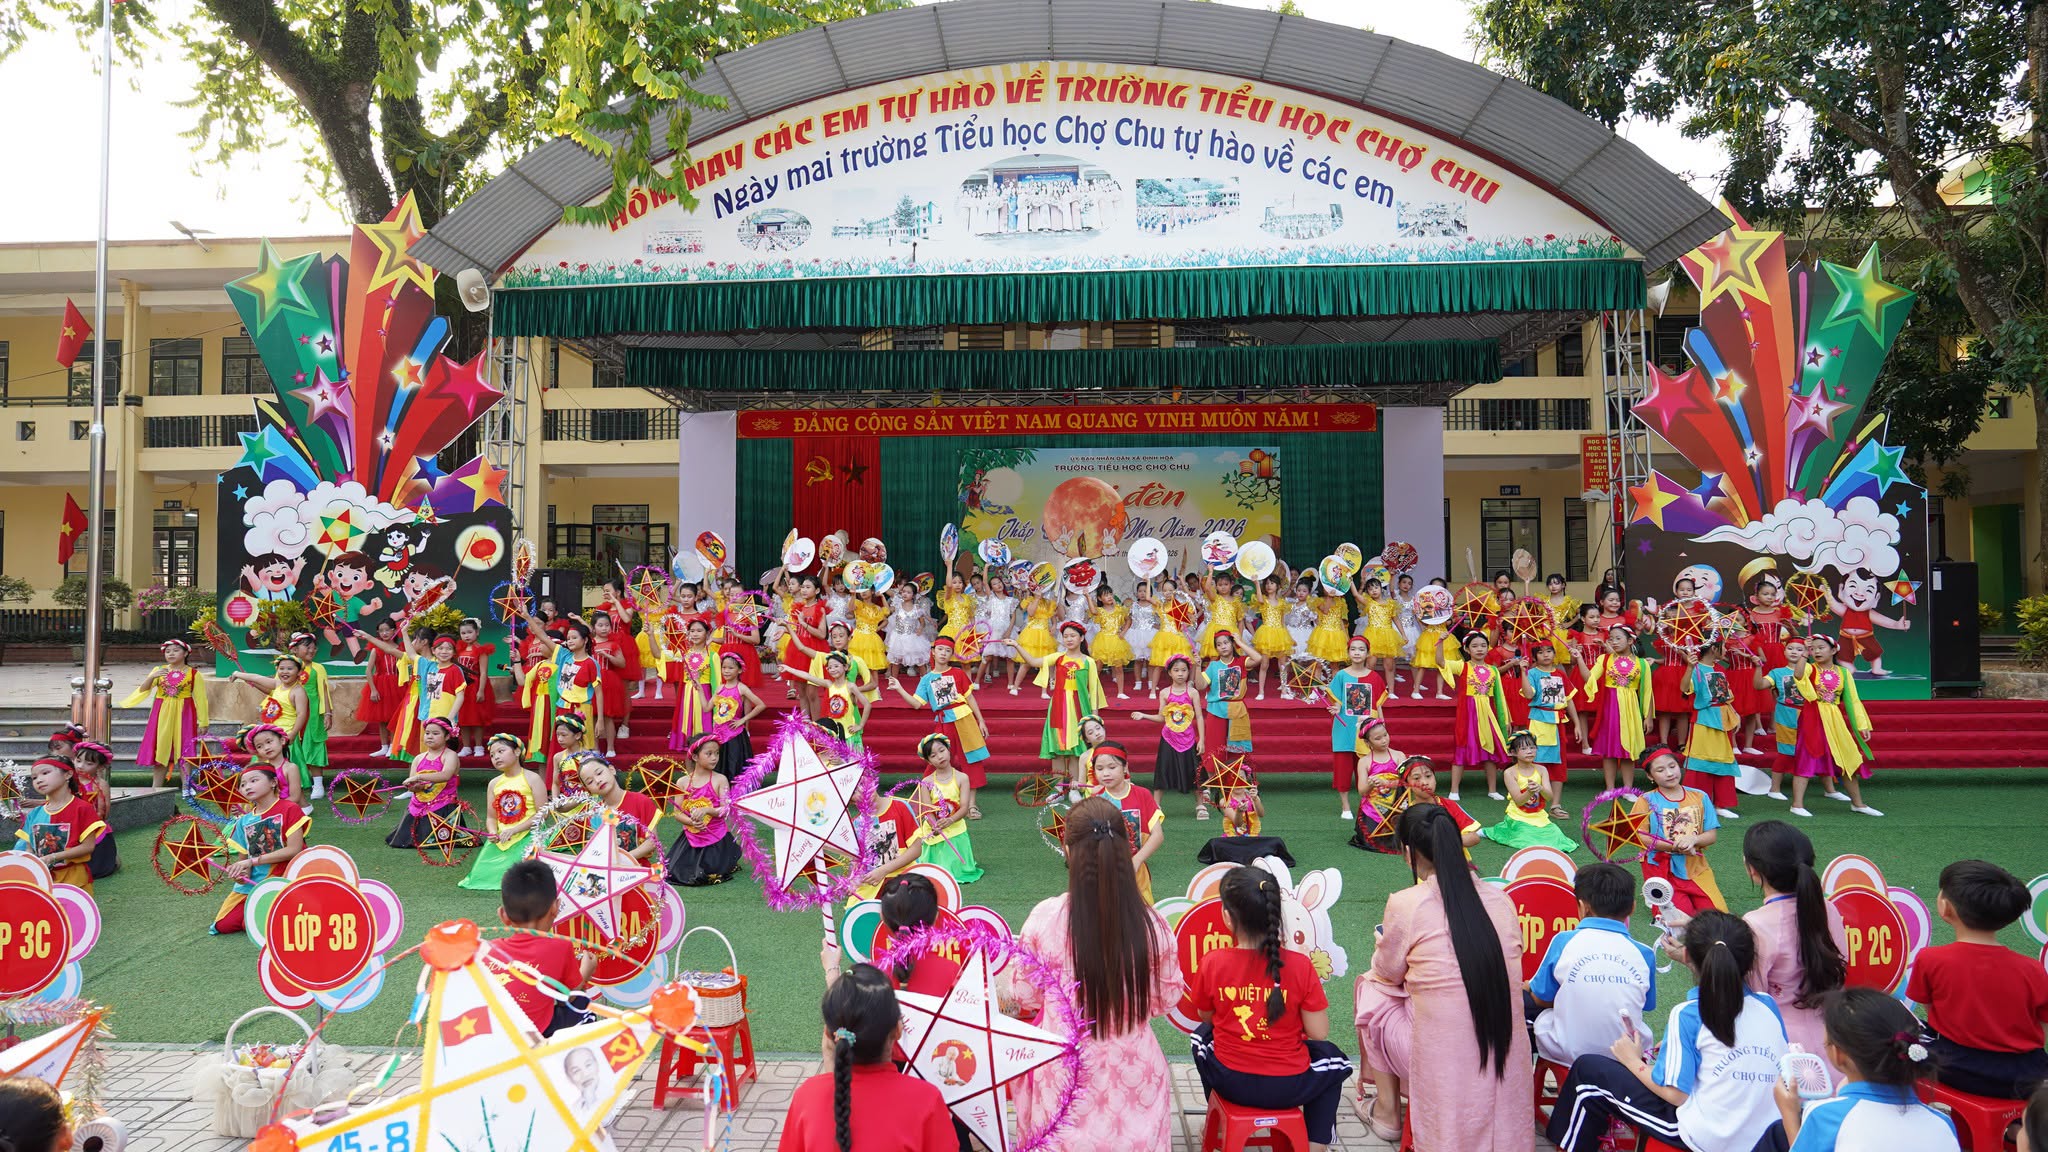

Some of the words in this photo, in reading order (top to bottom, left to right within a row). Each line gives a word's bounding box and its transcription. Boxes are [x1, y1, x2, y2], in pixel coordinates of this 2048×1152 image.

[684, 143, 743, 191] NAY
[754, 118, 814, 159] CÁC
[823, 104, 868, 138] EM
[879, 88, 922, 123] TỰ
[930, 81, 996, 114] HÀO
[1005, 70, 1045, 104] VỀ
[1057, 75, 1189, 109] TRƯỜNG
[1200, 84, 1274, 123] TIỂU
[1279, 105, 1351, 144] HỌC
[1356, 128, 1427, 173] CHỢ
[1431, 158, 1500, 205] CHU
[713, 174, 778, 219] Ngày
[787, 151, 833, 191] mai
[840, 132, 928, 174] trường
[935, 113, 993, 152] Tiểu
[1003, 117, 1047, 151] học
[1055, 115, 1107, 151] Chợ
[1115, 117, 1165, 149] Chu
[1174, 125, 1203, 160] tự
[1209, 128, 1255, 164] hào
[1263, 138, 1295, 173] về
[1302, 155, 1348, 190] các
[1355, 175, 1394, 208] em
[793, 412, 849, 432] ĐẢNG
[855, 412, 908, 434] CỘNG
[914, 410, 954, 431] SẢN
[960, 410, 1009, 432] VIỆT
[1015, 413, 1061, 430] NAM
[1067, 412, 1138, 430] QUANG
[1144, 412, 1195, 428] VINH
[1201, 408, 1257, 427] MUÔN
[1263, 407, 1309, 427] NĂM
[1122, 481, 1185, 508] đèn
[1159, 516, 1197, 539] Năm
[19, 919, 52, 960] 3C
[282, 903, 322, 952] LỚP
[328, 913, 358, 951] 3B
[1868, 924, 1892, 966] 2C
[1583, 974, 1606, 985] CHỢ
[1608, 975, 1631, 985] CHU
[955, 990, 980, 1005] Bác
[1218, 987, 1225, 1001] I
[1238, 983, 1261, 1003] VIỆT
[1005, 1048, 1035, 1061] Nhớ
[1732, 1070, 1757, 1084] CHỢ
[1757, 1073, 1776, 1083] CHU
[970, 1105, 988, 1129] Thu
